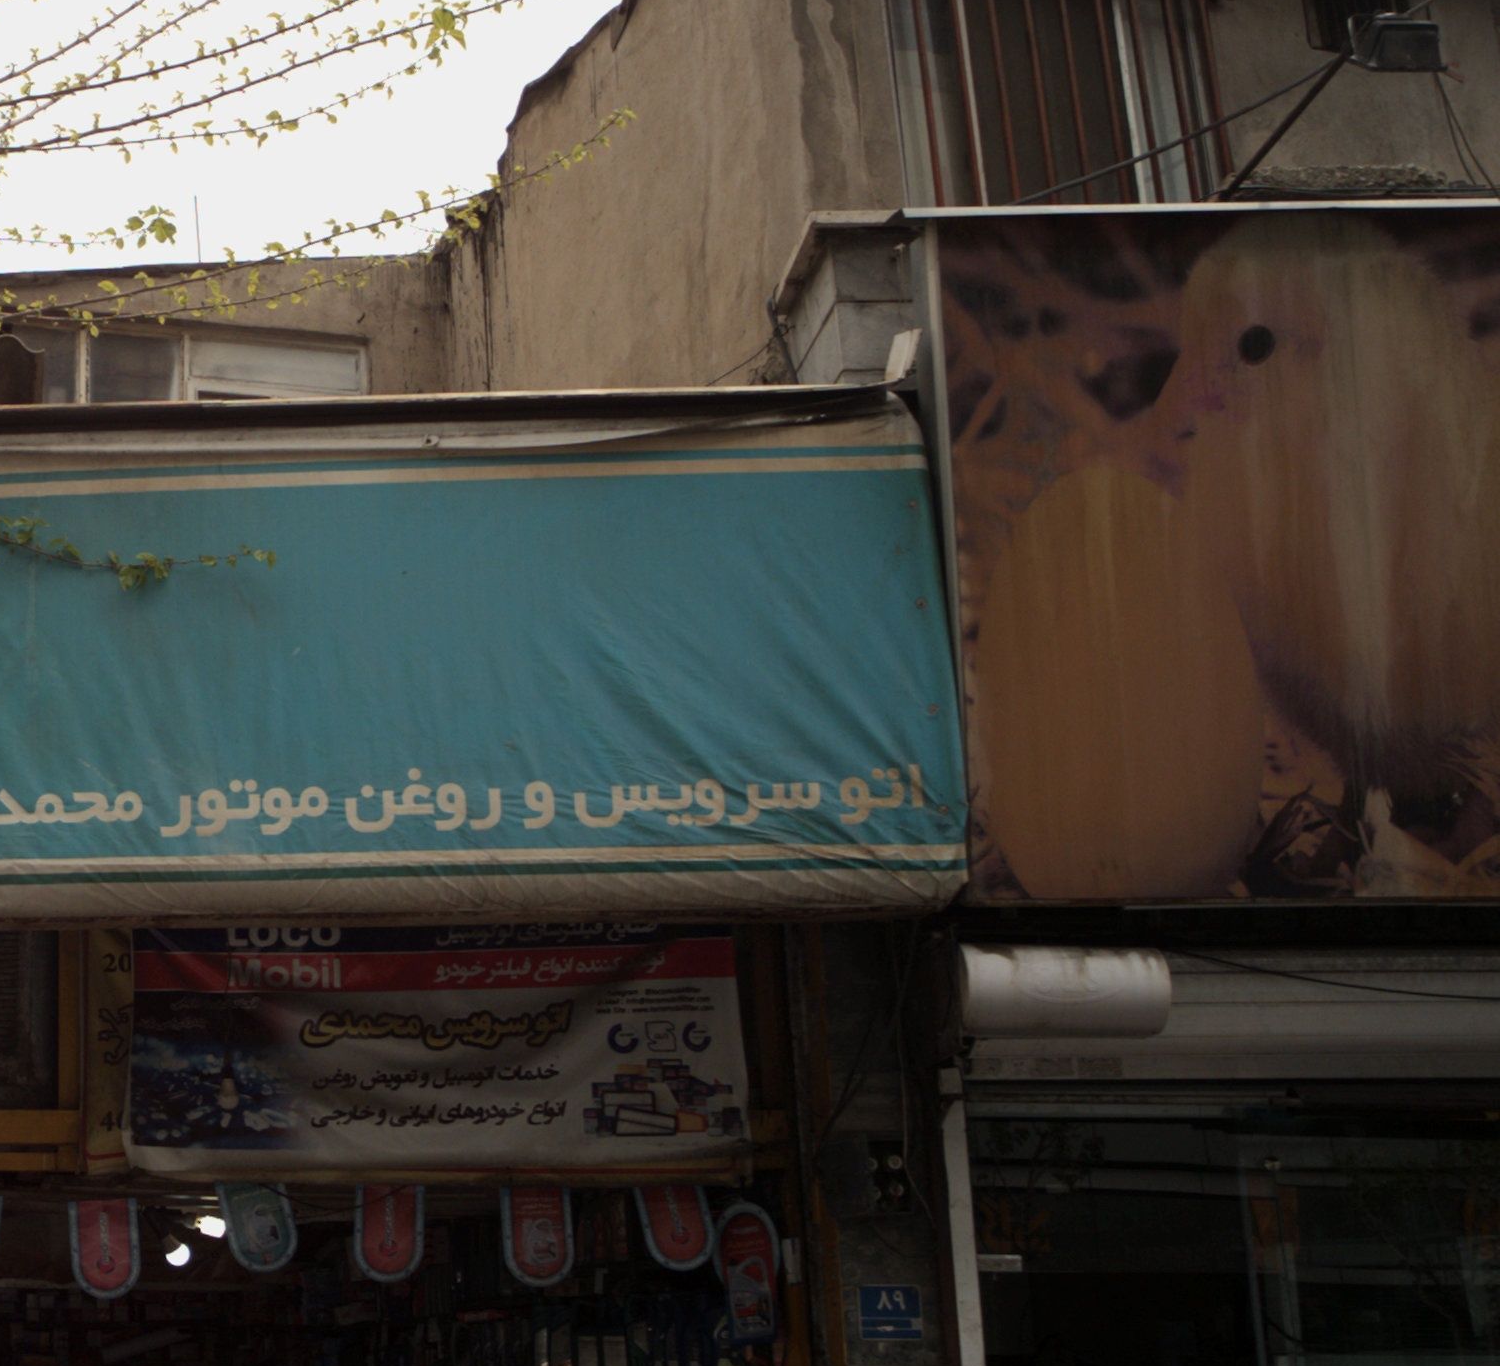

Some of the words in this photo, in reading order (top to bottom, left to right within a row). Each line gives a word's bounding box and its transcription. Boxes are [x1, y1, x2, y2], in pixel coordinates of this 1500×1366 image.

[159, 778, 329, 838] موتور
[344, 767, 500, 833] روغن
[523, 780, 555, 829] و
[574, 778, 822, 828] سرویس
[226, 957, 341, 989] Mobil
[433, 960, 486, 984] خودرو
[484, 955, 532, 984] فیلتر
[533, 956, 574, 983] انواع
[299, 1009, 424, 1048] محمدی
[423, 1009, 530, 1051] سرویس
[312, 1068, 357, 1089] روغن
[360, 1069, 418, 1090] تعویض
[420, 1071, 430, 1088] و
[497, 1064, 560, 1082] خدمات
[311, 1104, 375, 1127] خارجی
[377, 1108, 386, 1125] و
[390, 1104, 437, 1127] ایرانی
[438, 1102, 525, 1125] خودروهای
[527, 1100, 567, 1125] انواع
[876, 1289, 907, 1311] ۸۹
